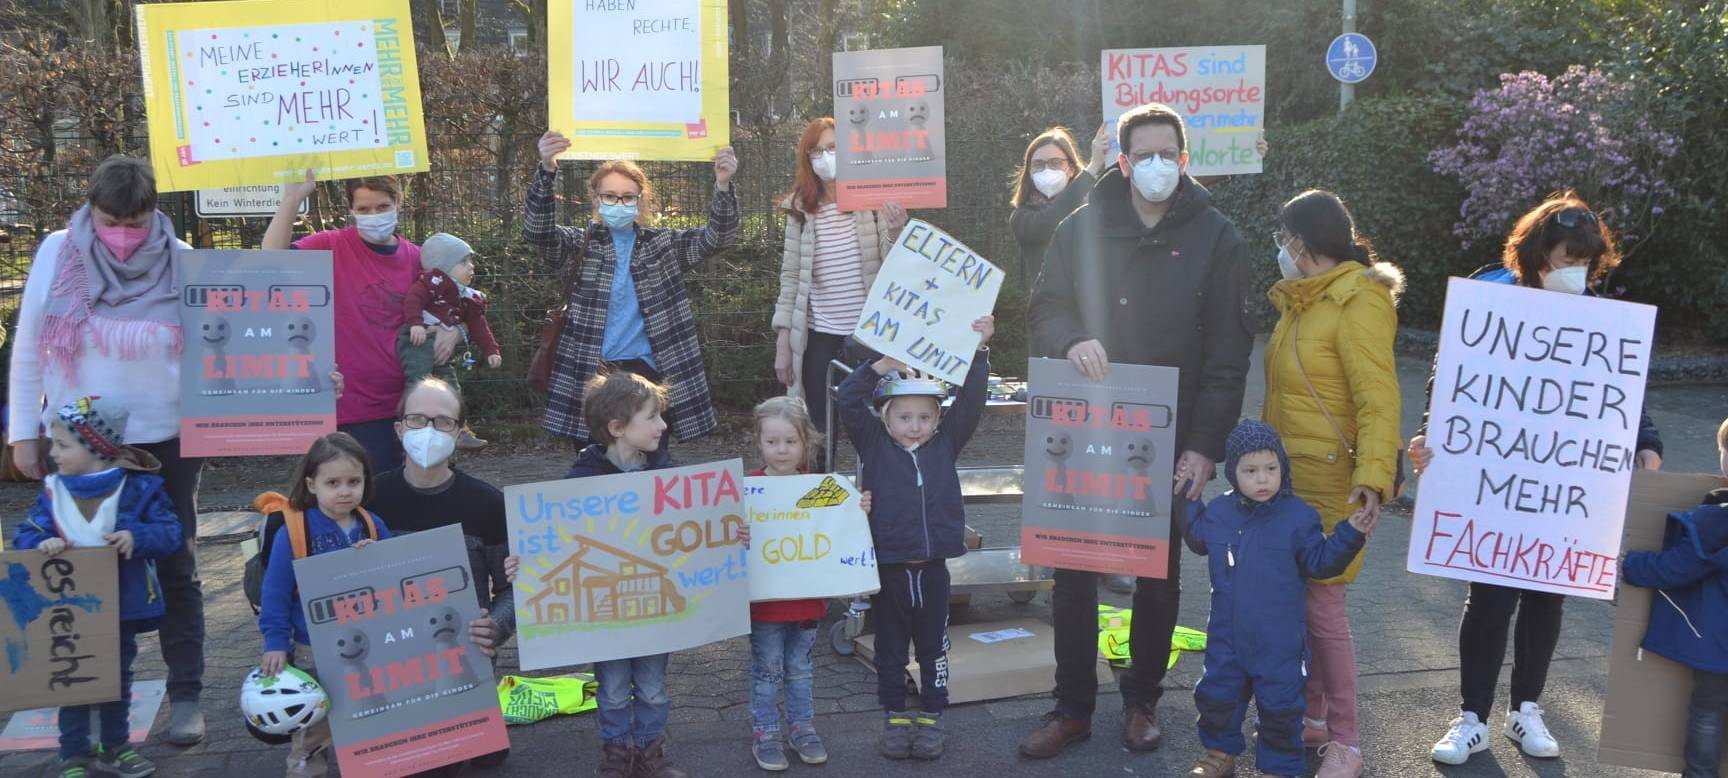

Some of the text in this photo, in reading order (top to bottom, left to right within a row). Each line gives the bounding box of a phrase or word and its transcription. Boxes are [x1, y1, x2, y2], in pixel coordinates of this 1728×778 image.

[200, 41, 265, 68] MEINE
[1107, 53, 1246, 81] KITAS sind
[581, 58, 700, 93] WIR AUCH!
[223, 87, 354, 126] SIND MEHR
[878, 109, 899, 119] AM
[1115, 79, 1261, 114] Bildungsorte
[850, 129, 929, 154] LIMIT
[207, 199, 229, 208] Kein
[902, 224, 992, 289] ELTERN
[207, 289, 312, 314] KITAS
[883, 281, 945, 326] KITAS
[244, 327, 272, 338] AM
[860, 310, 968, 375] AM LIMIT
[1460, 308, 1642, 376] UNSERE
[203, 353, 316, 381] LIMIT
[1451, 364, 1628, 429] KINDER
[1051, 402, 1153, 432] KITAS
[1086, 444, 1112, 456] AM
[1442, 415, 1632, 473] BRAUCHEN
[518, 468, 741, 523] Unsere KITA
[1044, 468, 1153, 501] LIMIT
[1476, 468, 1588, 518] MEHR
[517, 514, 745, 557] ist GOLD
[762, 532, 832, 564] GOLD
[1424, 511, 1617, 587] FACHKRÄFTE
[677, 550, 747, 588] wert!
[333, 576, 449, 625] KITAS
[384, 627, 414, 644] AM
[346, 647, 465, 701] LIMIT
